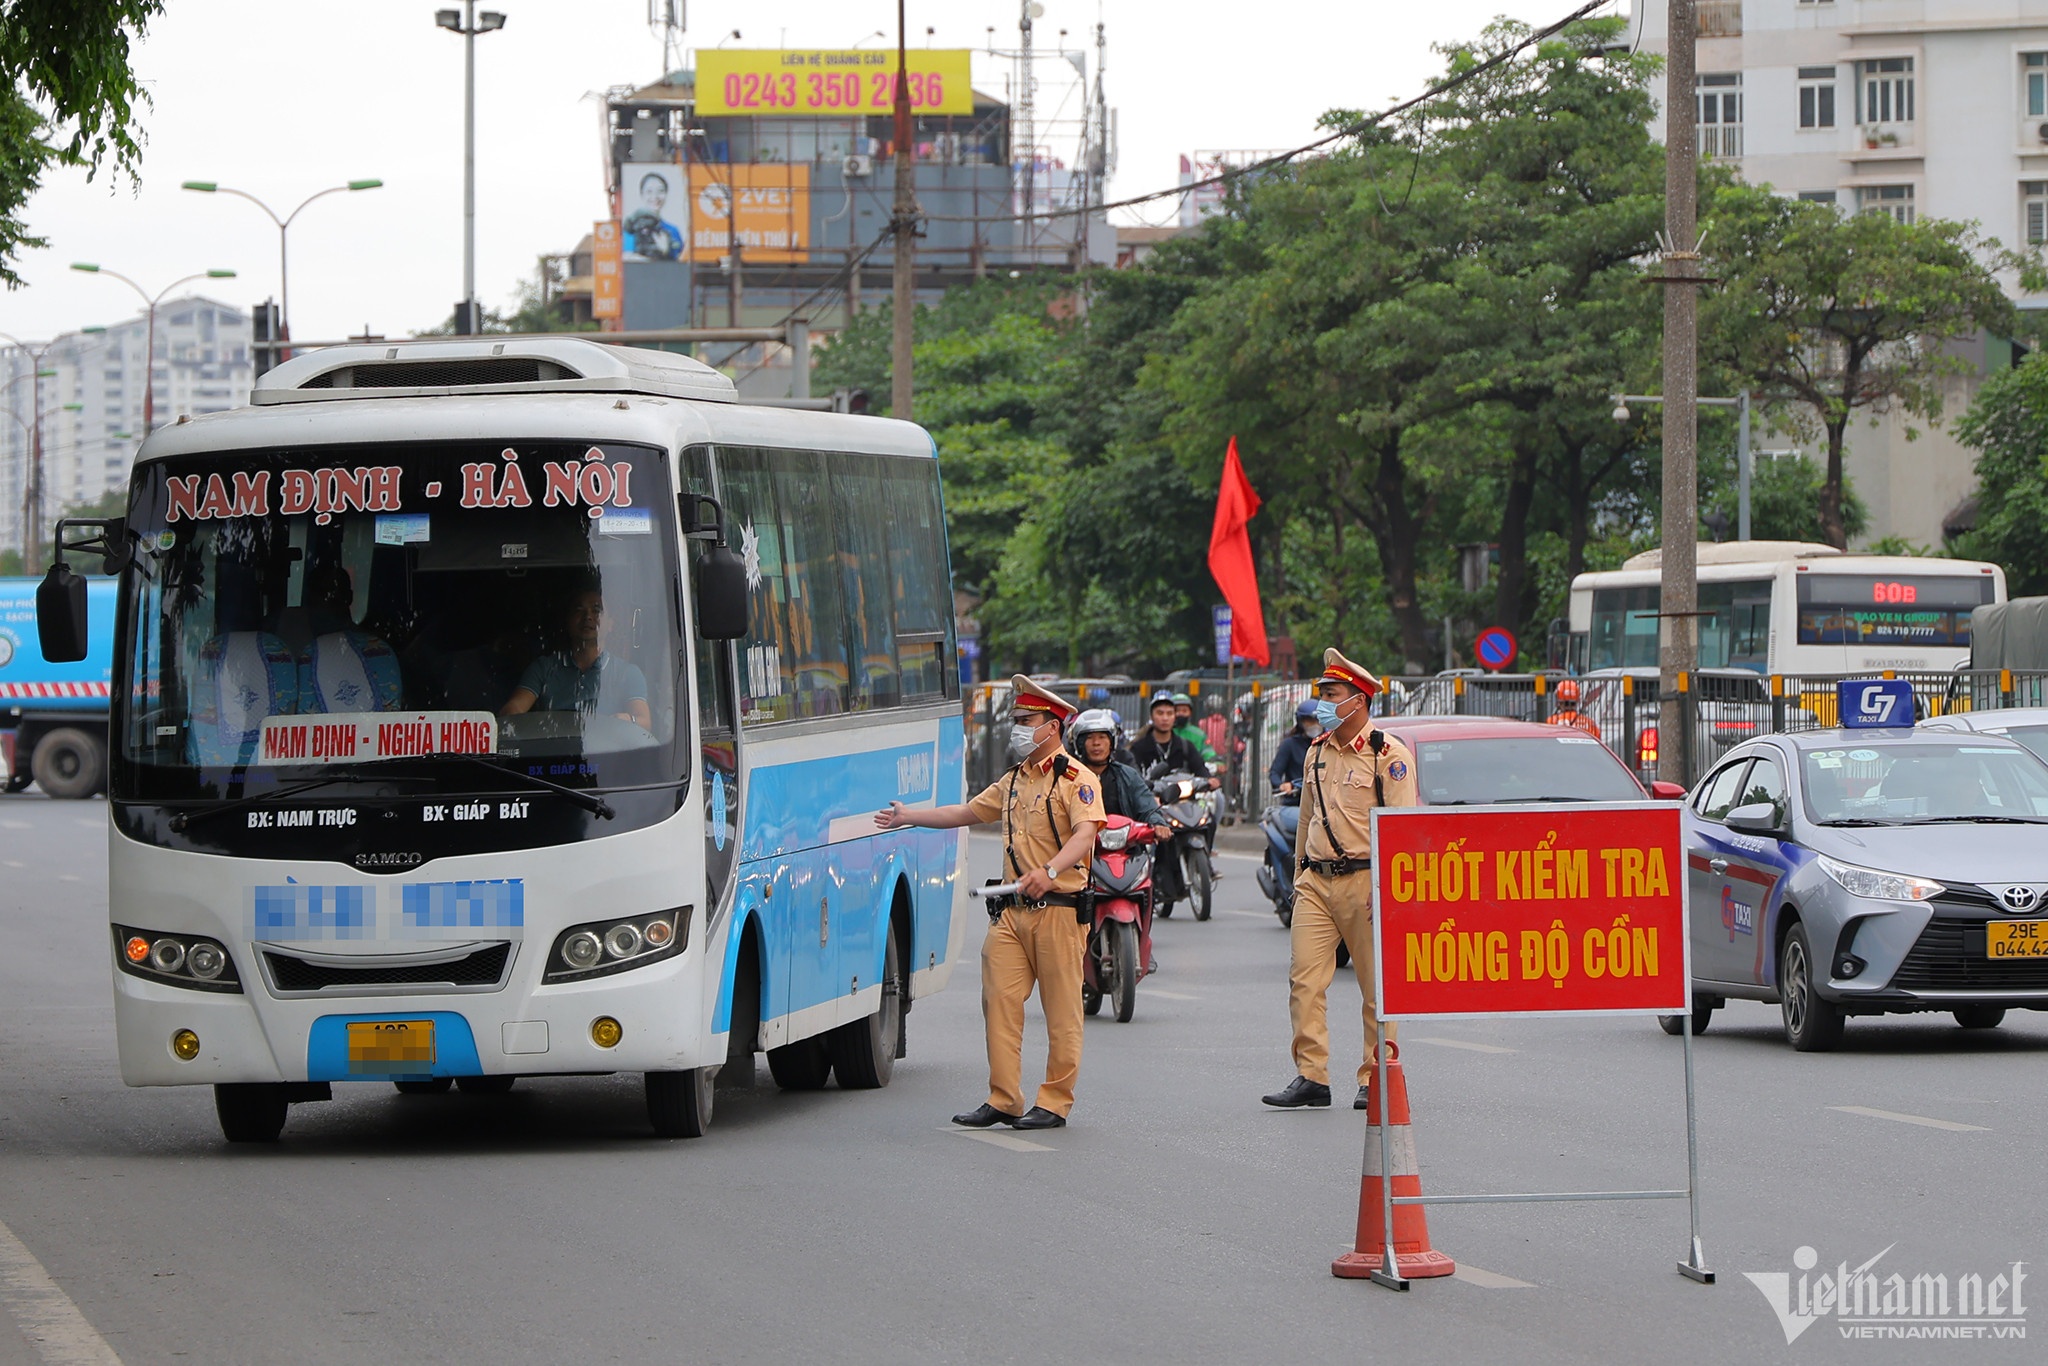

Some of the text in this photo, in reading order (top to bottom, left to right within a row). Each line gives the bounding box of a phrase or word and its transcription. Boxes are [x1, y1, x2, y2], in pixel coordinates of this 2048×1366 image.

[724, 72, 796, 108] 0243
[807, 72, 860, 108] 350
[166, 446, 632, 525] NAM ĐỊNH - HÀ NỘI
[1873, 582, 1917, 603] 60B
[1904, 613, 1940, 622] GROUP
[1877, 626, 1893, 636] 024
[1860, 686, 1896, 723] G7
[1857, 715, 1877, 723] TAXI
[265, 726, 307, 759] NAM
[312, 724, 356, 762] ĐỊNH
[378, 715, 434, 756] NGHĨA
[528, 765, 543, 775] BX
[550, 763, 575, 775] GIÁP
[247, 808, 356, 829] BX: NAM TRỰC
[453, 799, 490, 821] GIÁP
[499, 797, 530, 820] BÁT
[355, 852, 422, 866] SAMCO
[1391, 830, 1670, 903] CHỐT KIỂM TRA
[1735, 903, 1752, 928] TAXI
[2008, 923, 2039, 939] 29E
[1405, 913, 1659, 989] NỒNG ĐỘ CỒN
